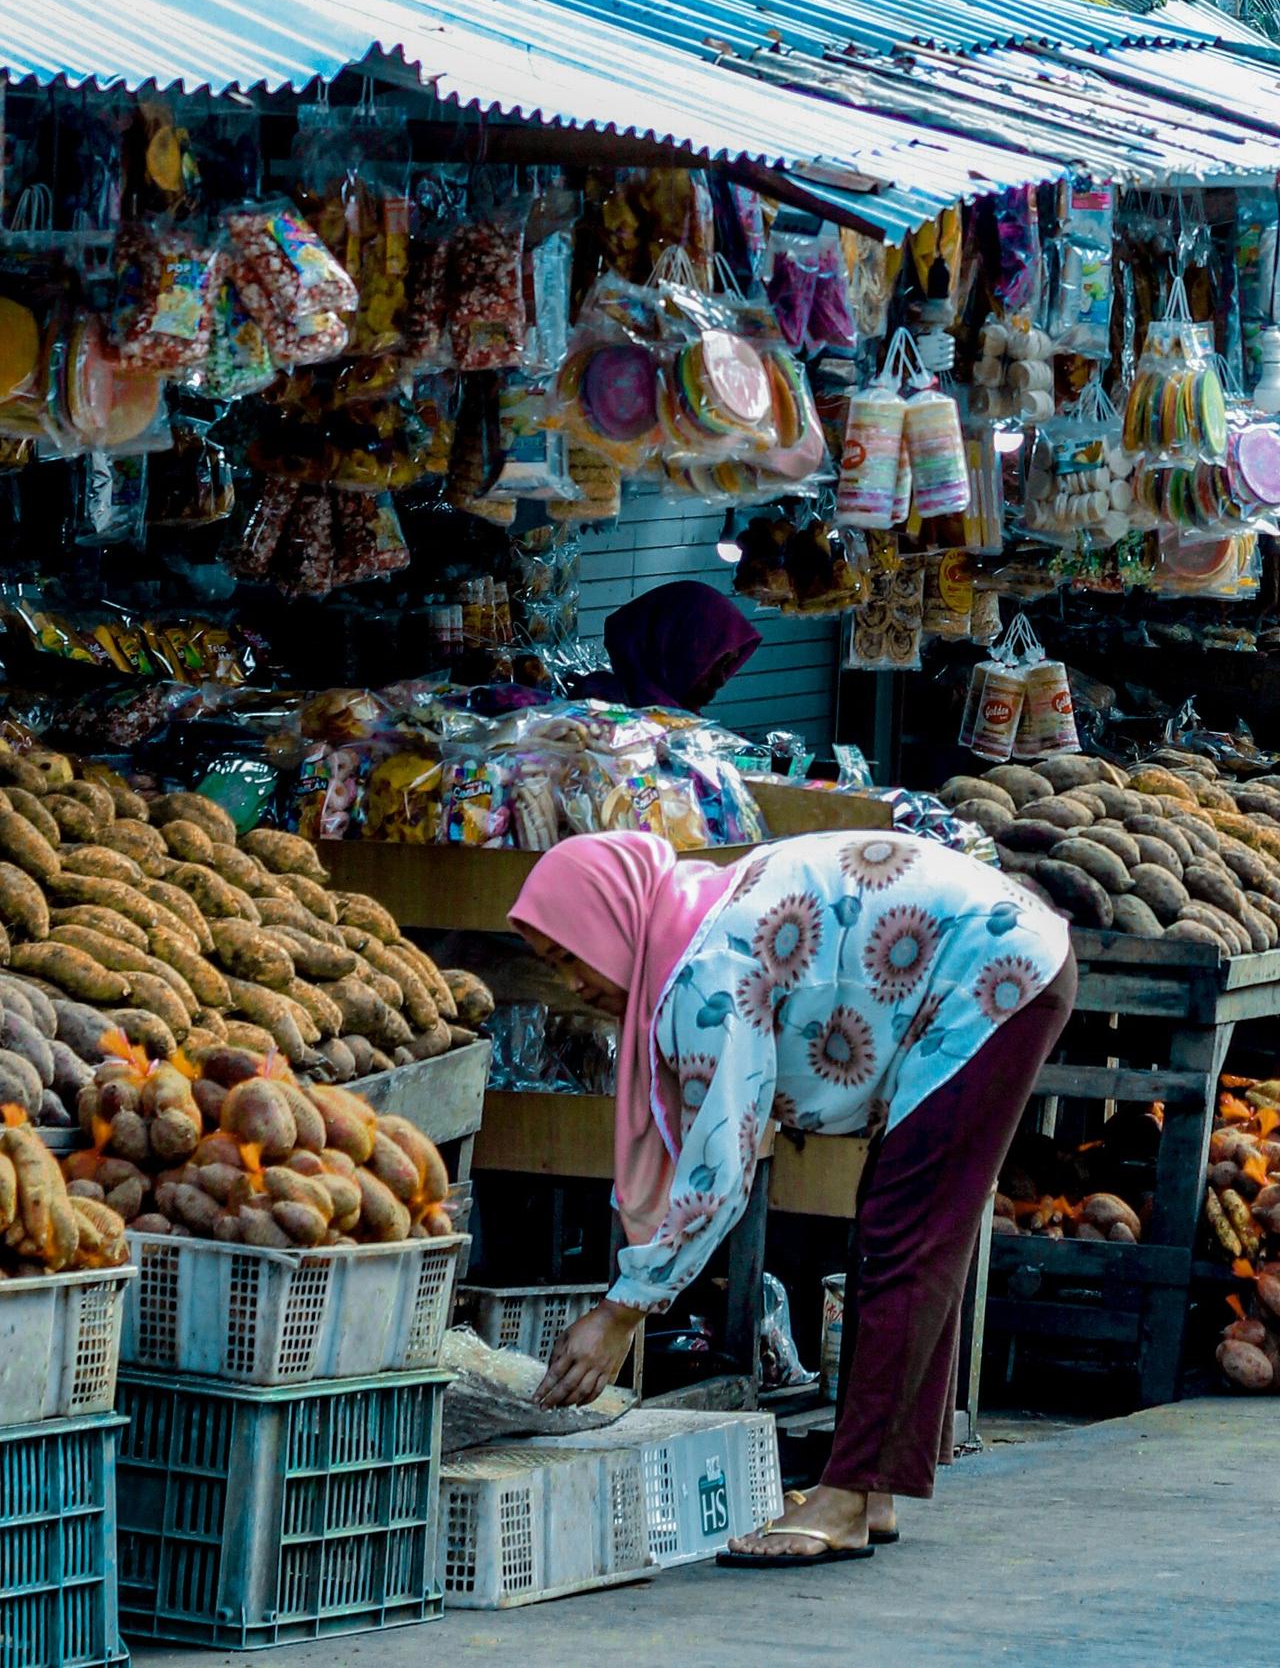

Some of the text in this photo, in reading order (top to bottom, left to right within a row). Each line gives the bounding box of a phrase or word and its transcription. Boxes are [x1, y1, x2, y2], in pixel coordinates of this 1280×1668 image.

[166, 263, 191, 273] POP
[985, 705, 1009, 719] Golden
[702, 1488, 727, 1532] HS
